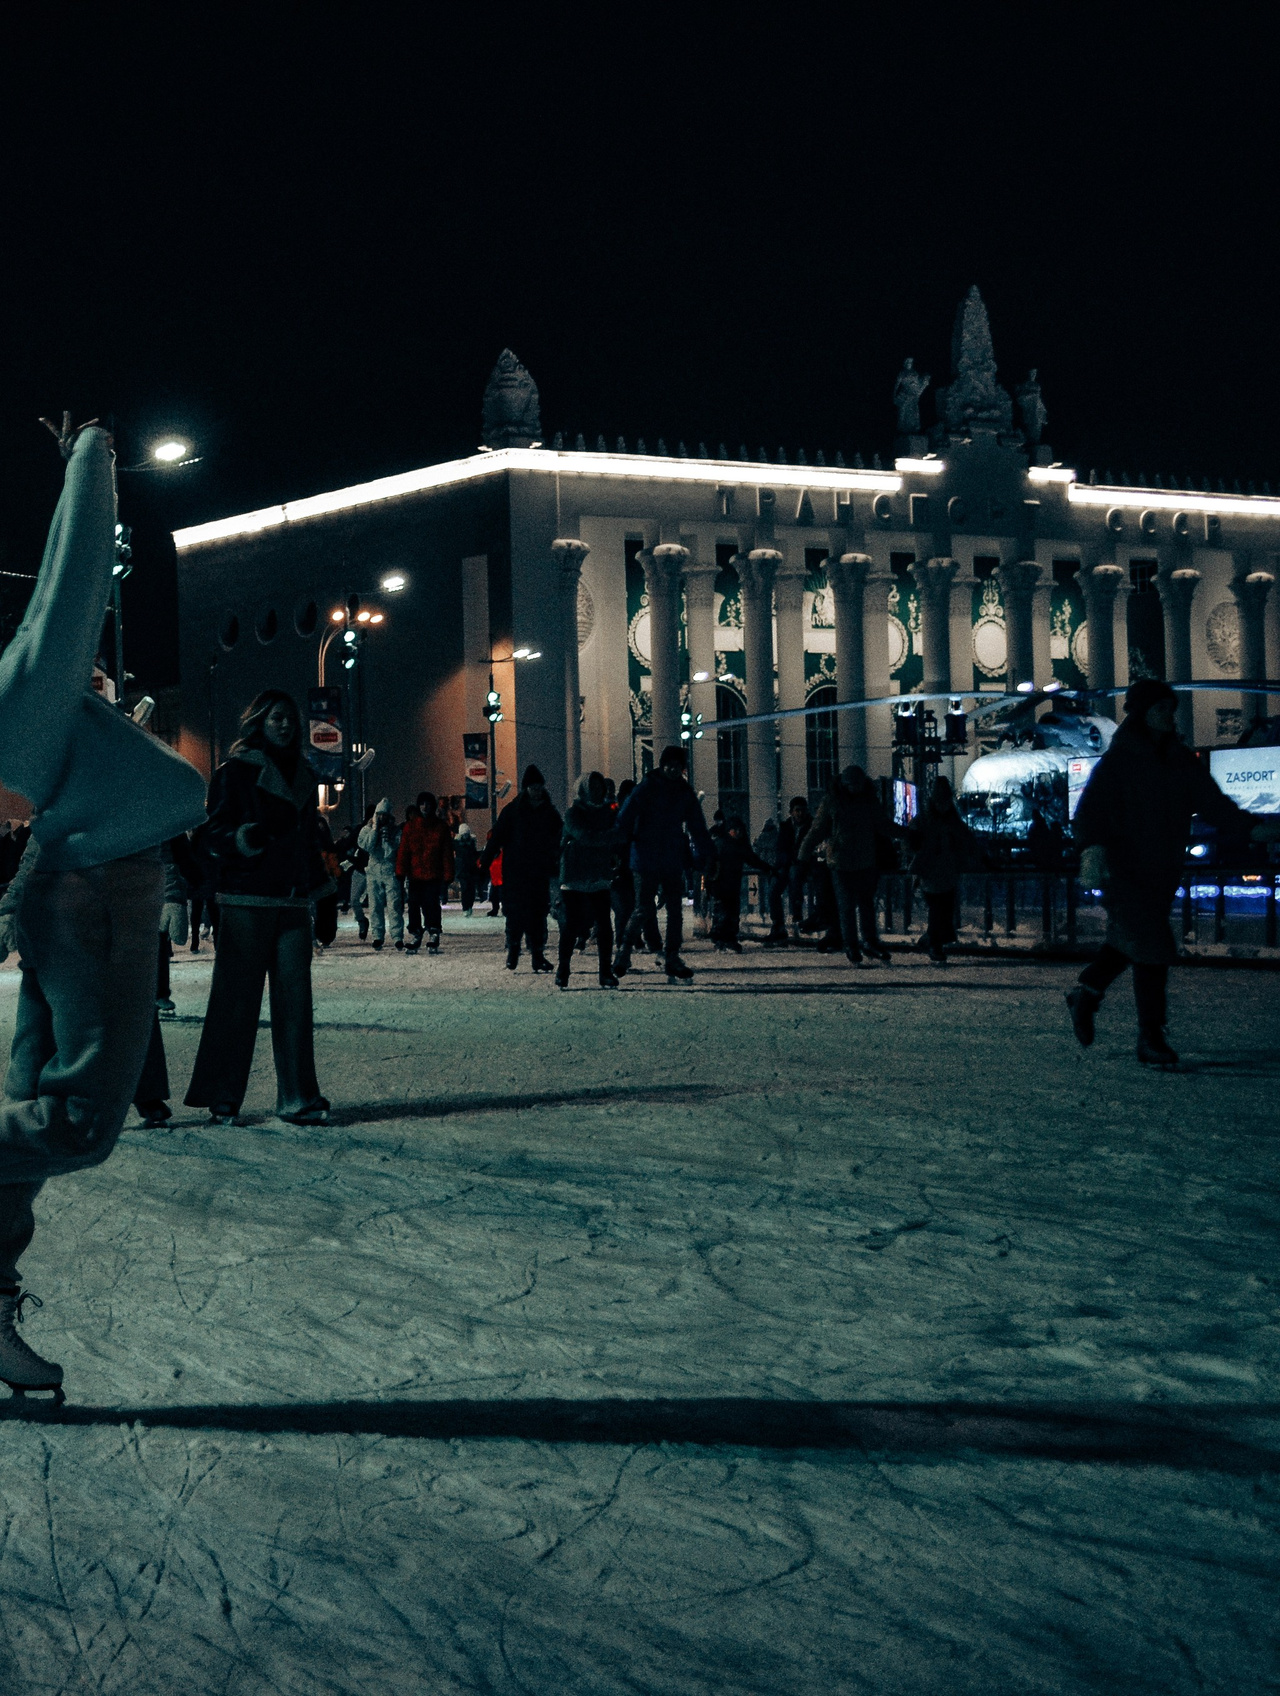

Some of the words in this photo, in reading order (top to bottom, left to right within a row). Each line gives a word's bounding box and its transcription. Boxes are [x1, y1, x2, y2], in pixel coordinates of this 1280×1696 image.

[716, 484, 1042, 528] ТРАНСПОТ
[1106, 507, 1220, 541] СССР
[1226, 770, 1276, 783] ZASPORT
